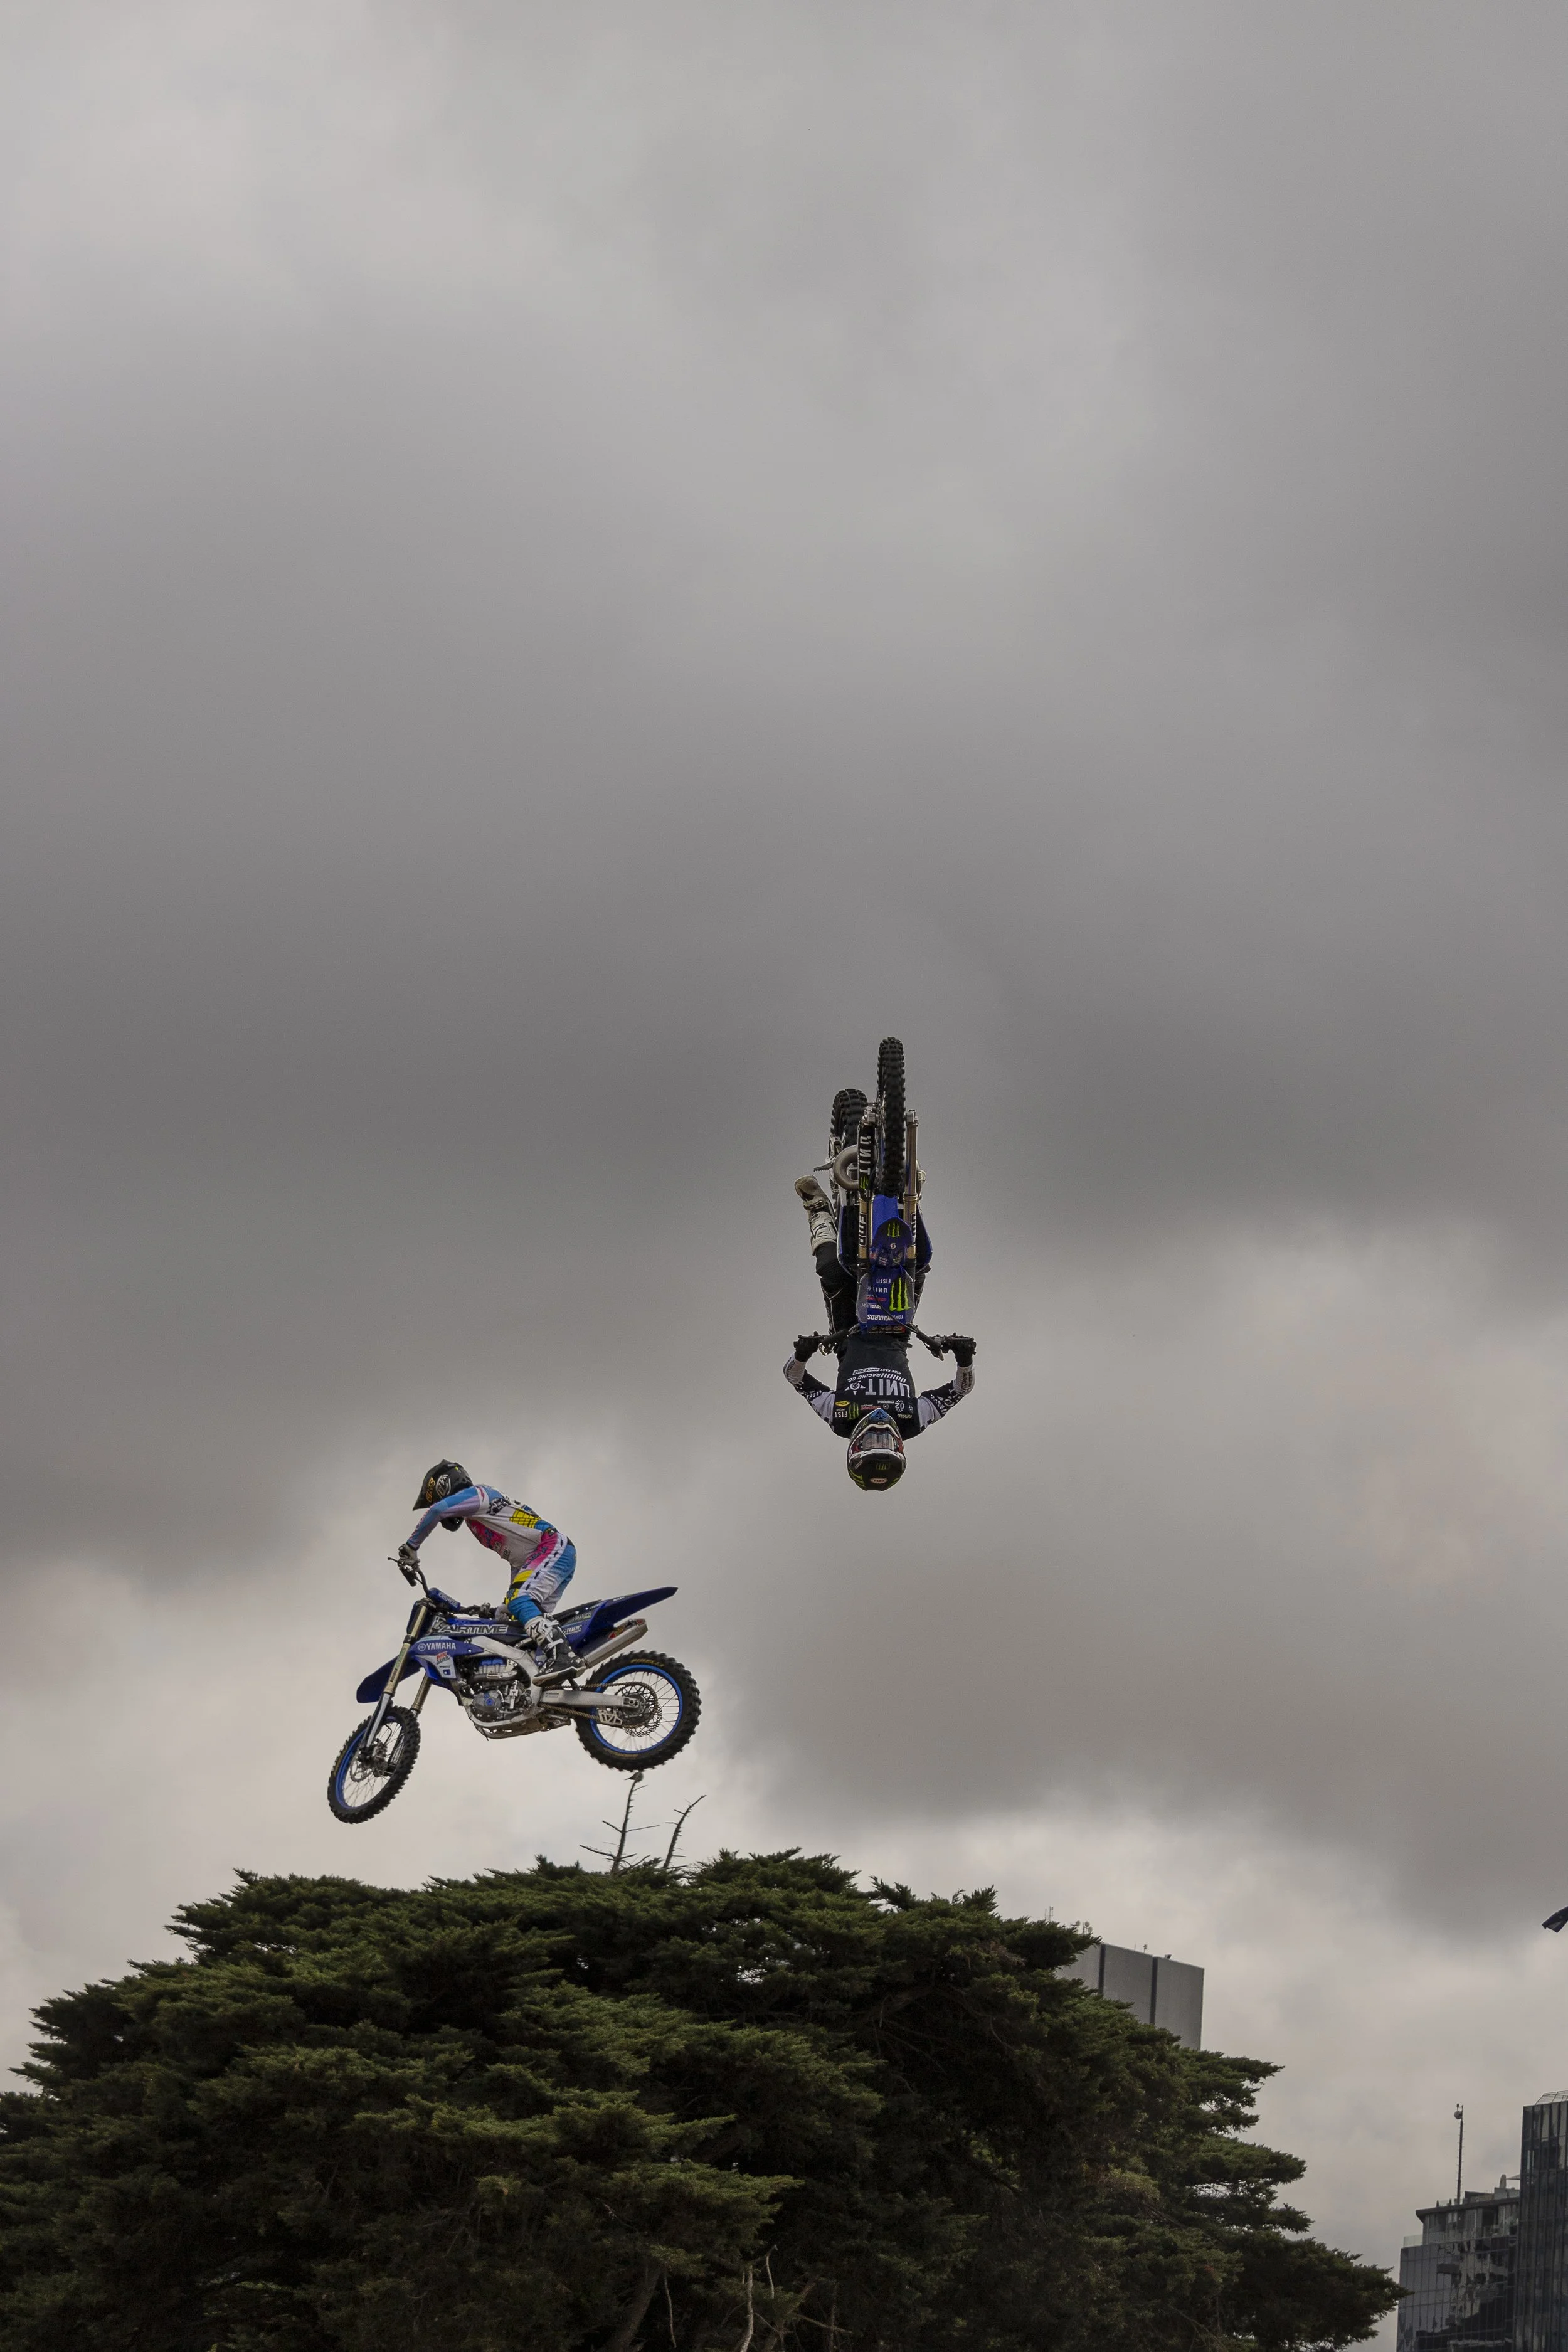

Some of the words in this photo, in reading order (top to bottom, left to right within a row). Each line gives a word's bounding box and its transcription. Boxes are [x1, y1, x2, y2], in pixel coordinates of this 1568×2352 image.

[859, 1136, 871, 1175] UNIT
[865, 1379, 911, 1398] UNIT
[426, 1642, 457, 1650] YAMAHA
